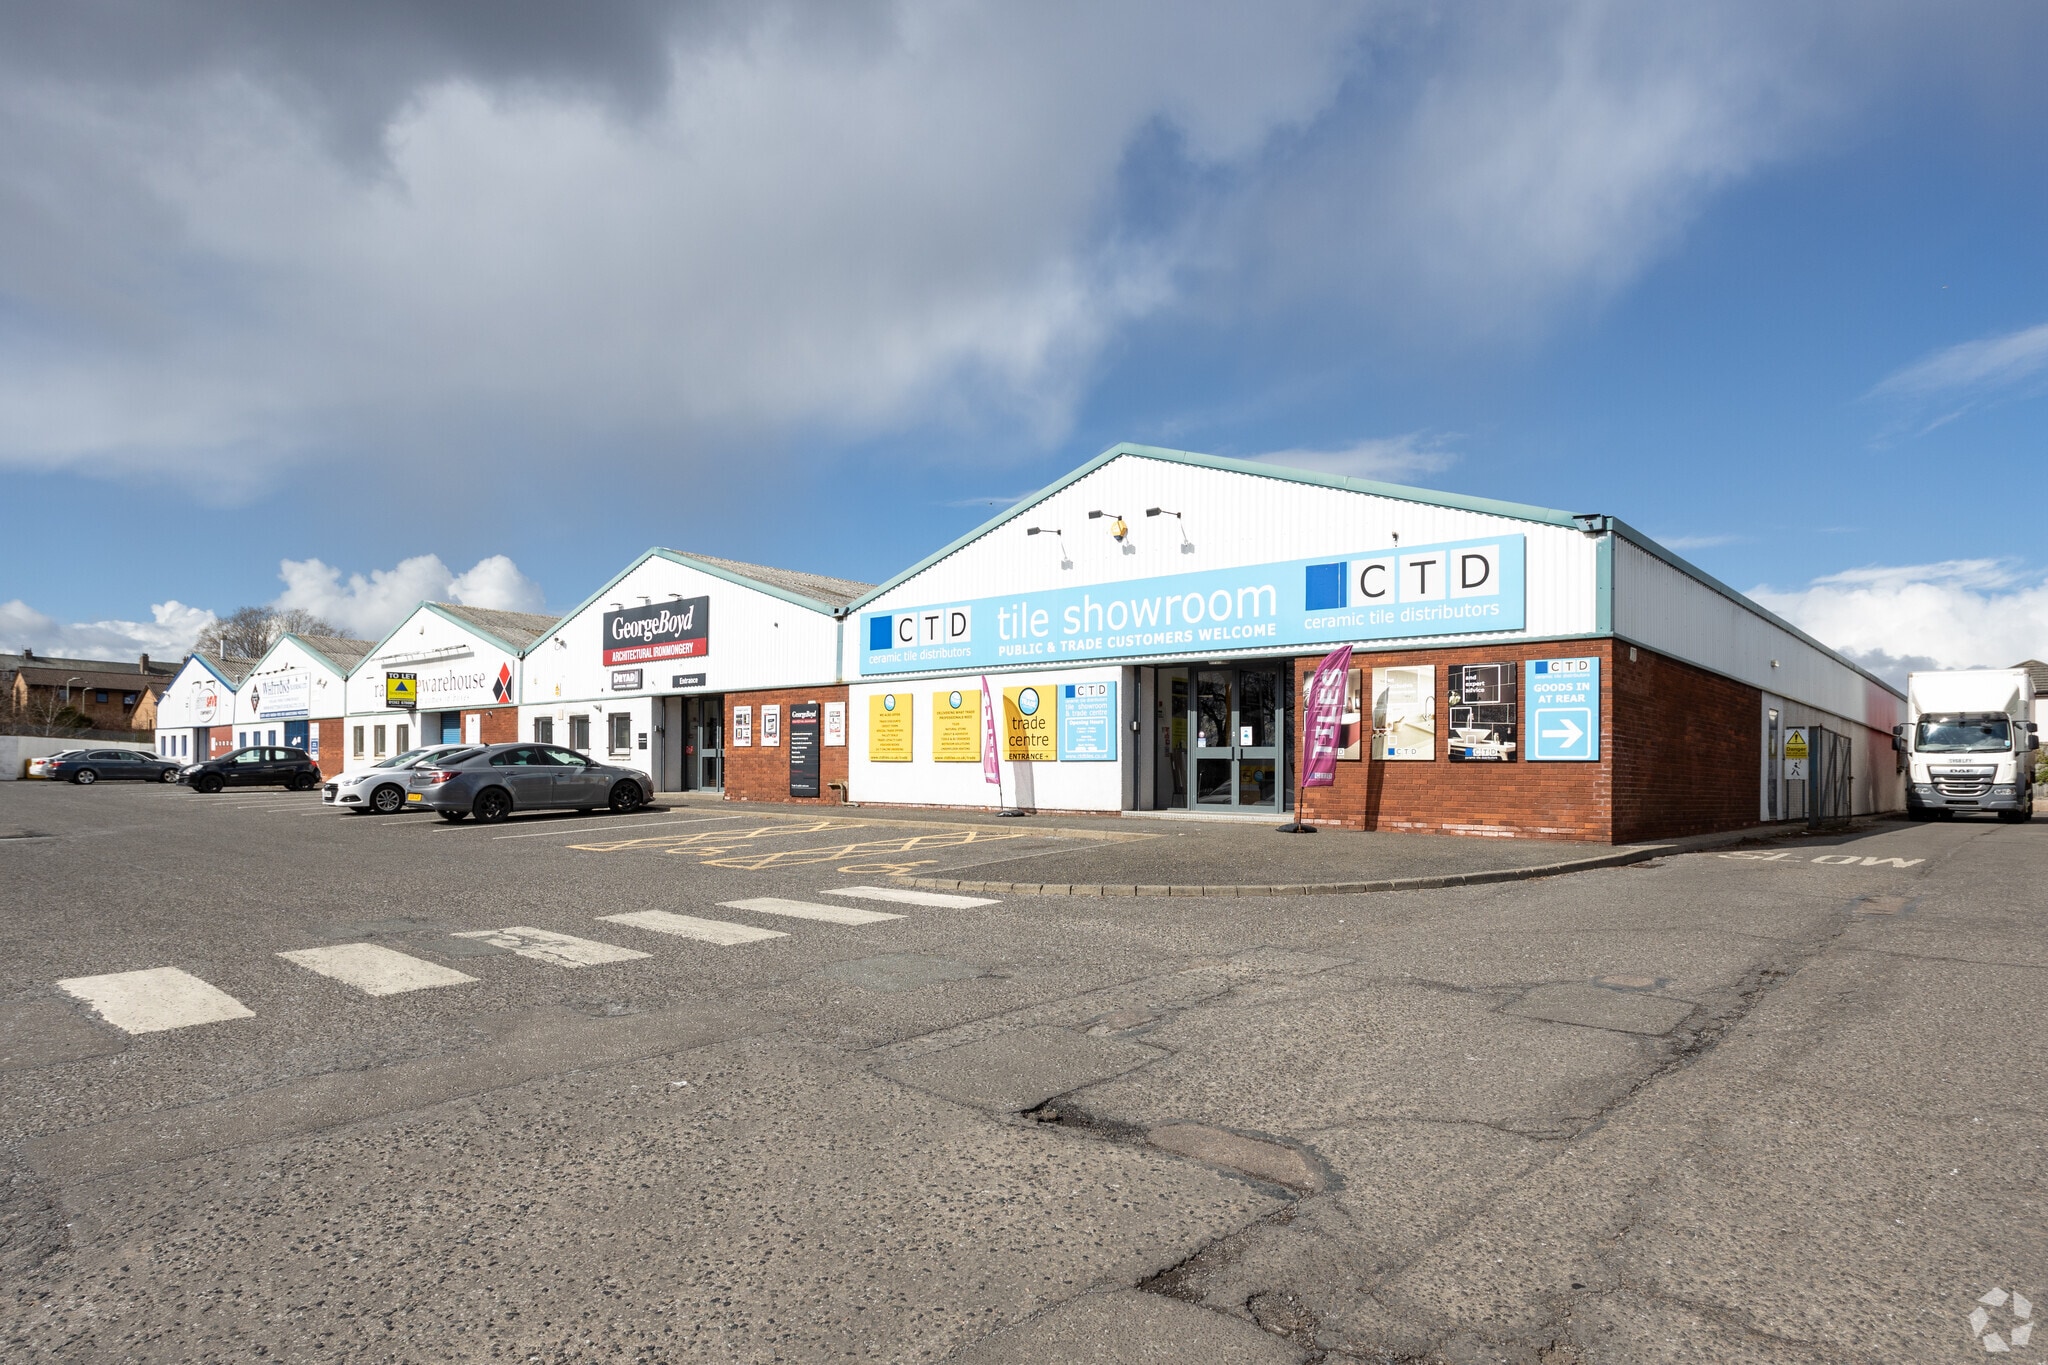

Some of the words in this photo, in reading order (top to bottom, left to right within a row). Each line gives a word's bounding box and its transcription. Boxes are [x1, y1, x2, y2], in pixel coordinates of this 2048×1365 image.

[1360, 554, 1489, 598] CTD
[998, 601, 1049, 640] tile
[1063, 584, 1277, 635] showroom
[1304, 612, 1364, 630] ceramic
[1369, 609, 1394, 625] tile
[1400, 602, 1499, 623] distributors
[612, 605, 694, 641] GeorgeBoyd
[899, 612, 966, 642] CTD
[998, 642, 1043, 657] PUBLIC
[1047, 641, 1057, 653] &
[1060, 637, 1102, 652] TRADE
[1107, 630, 1193, 649] CUSTOMERS
[1198, 623, 1276, 642] WELCOME
[612, 648, 652, 662] ARCHITECTURAL
[653, 642, 693, 657] IRONMONGERY
[869, 652, 901, 664] ceramic
[904, 650, 917, 660] tile
[919, 647, 971, 660] distributors
[1551, 660, 1588, 671] CTD
[680, 677, 698, 685] Entrance
[1534, 682, 1573, 692] GOODS
[1576, 682, 1590, 691] IN
[1078, 684, 1106, 696] CTD
[1078, 702, 1108, 710] showroom
[1538, 695, 1553, 704] AT
[1555, 694, 1585, 703] REAR
[1312, 668, 1342, 759] TILES
[1012, 716, 1046, 730] trade
[1008, 734, 1049, 746] centre
[1717, 851, 1927, 868] SLOW
